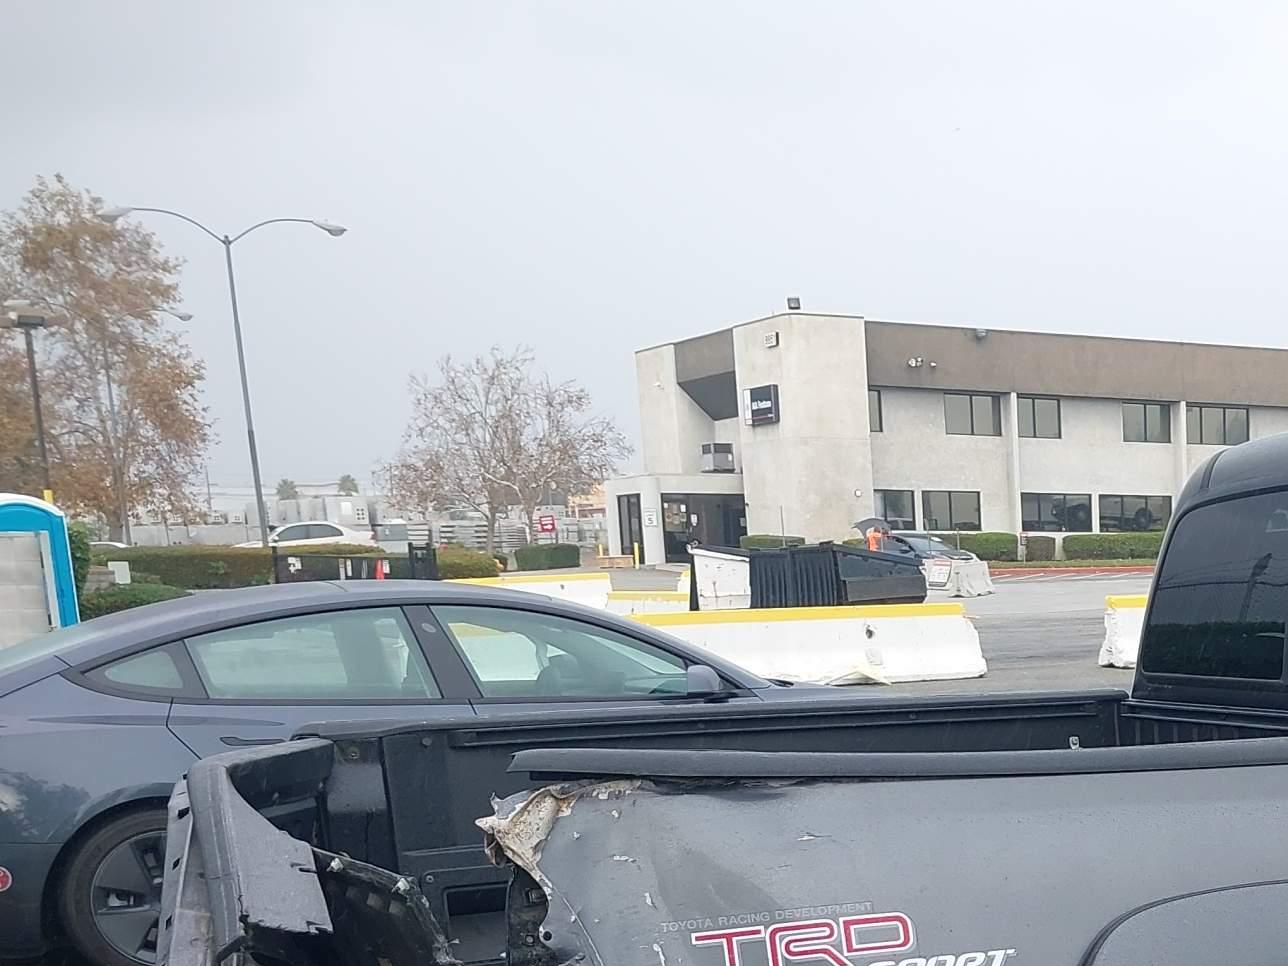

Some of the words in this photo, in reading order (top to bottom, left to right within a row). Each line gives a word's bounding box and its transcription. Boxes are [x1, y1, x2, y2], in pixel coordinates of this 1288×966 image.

[660, 917, 714, 933] TOYOTA
[718, 911, 770, 927] RACING
[774, 901, 874, 921] DEVELOPMENT
